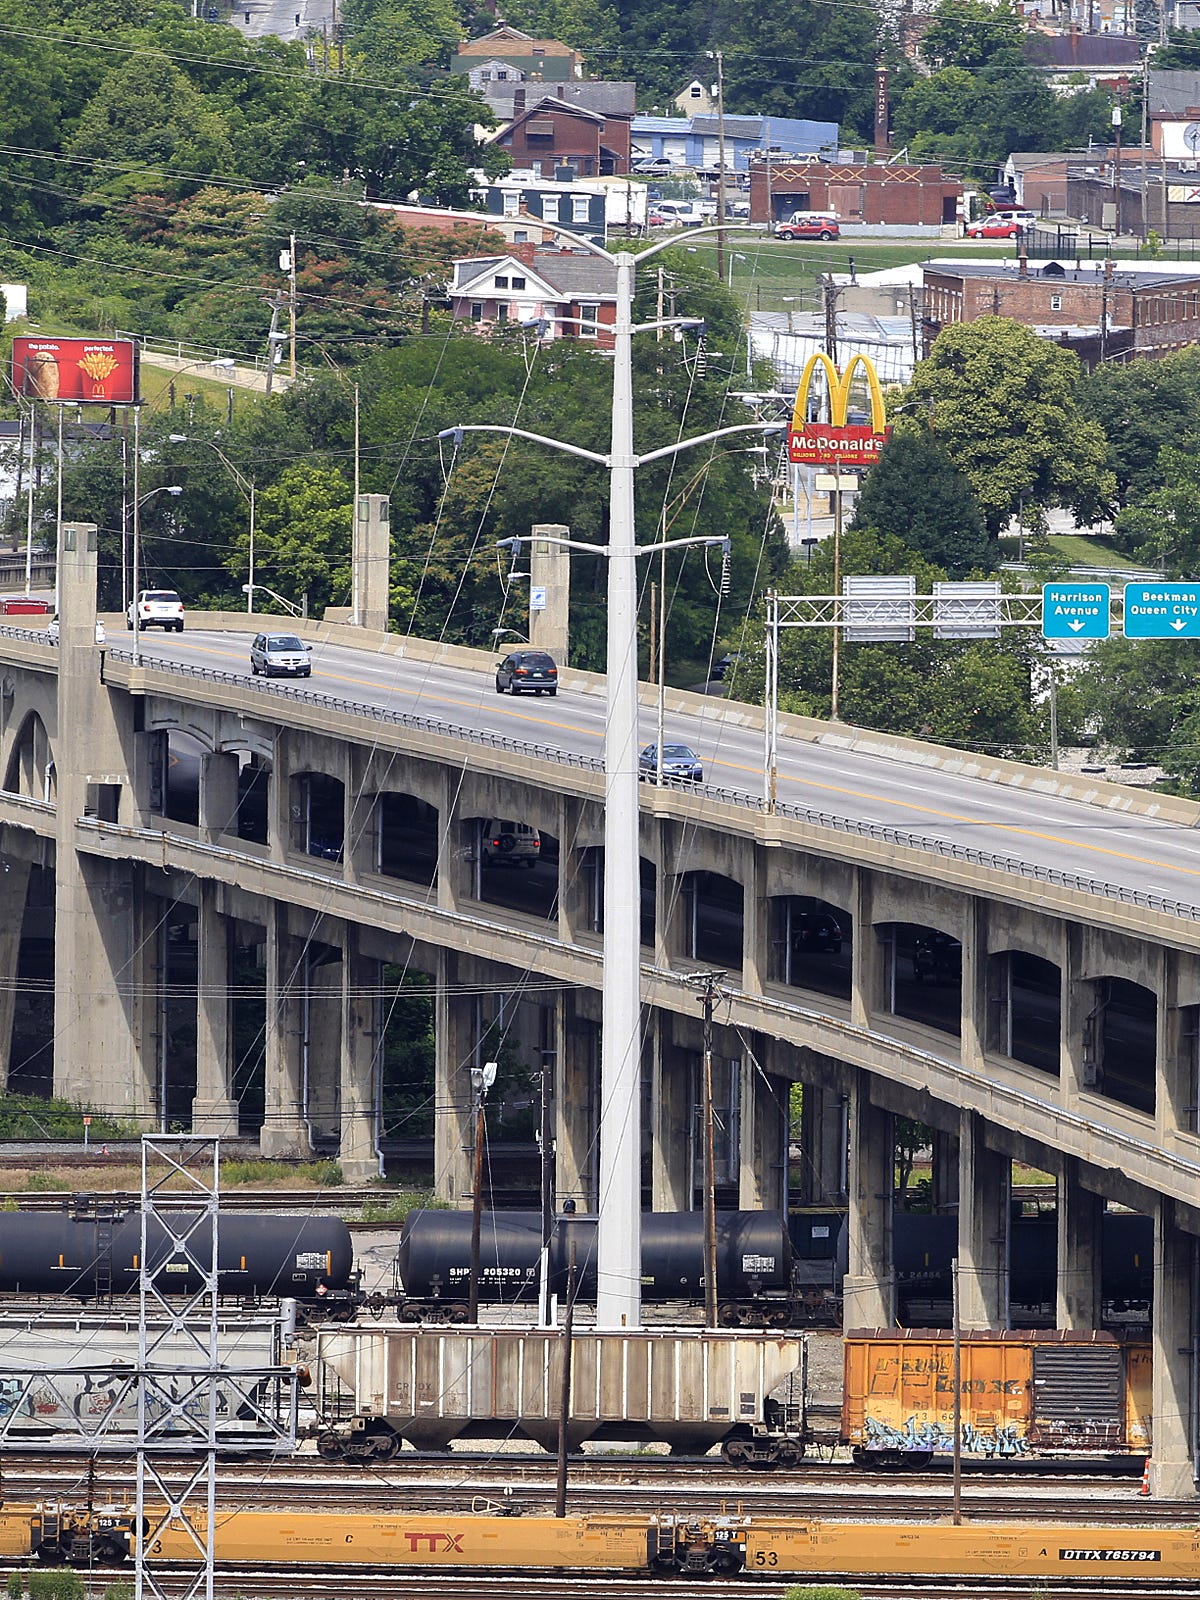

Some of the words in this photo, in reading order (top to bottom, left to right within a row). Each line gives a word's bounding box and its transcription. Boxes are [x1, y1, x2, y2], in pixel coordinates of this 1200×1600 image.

[28, 342, 39, 351] the
[791, 435, 884, 451] McDonald's
[1050, 591, 1103, 602] Harrison
[1142, 591, 1197, 602] Beekman
[1054, 605, 1099, 616] Avenue
[1130, 605, 1168, 615] Queen
[1172, 605, 1198, 617] City
[449, 1267, 472, 1276] SHP
[483, 1267, 522, 1276] 205320
[99, 1519, 112, 1527] 125
[345, 1534, 354, 1544] C
[715, 1531, 729, 1539] 125
[404, 1532, 465, 1553] TTX
[1038, 1548, 1048, 1557] A
[1063, 1550, 1101, 1560] DTTX
[1104, 1550, 1156, 1561] 765794
[755, 1551, 778, 1566] 53
